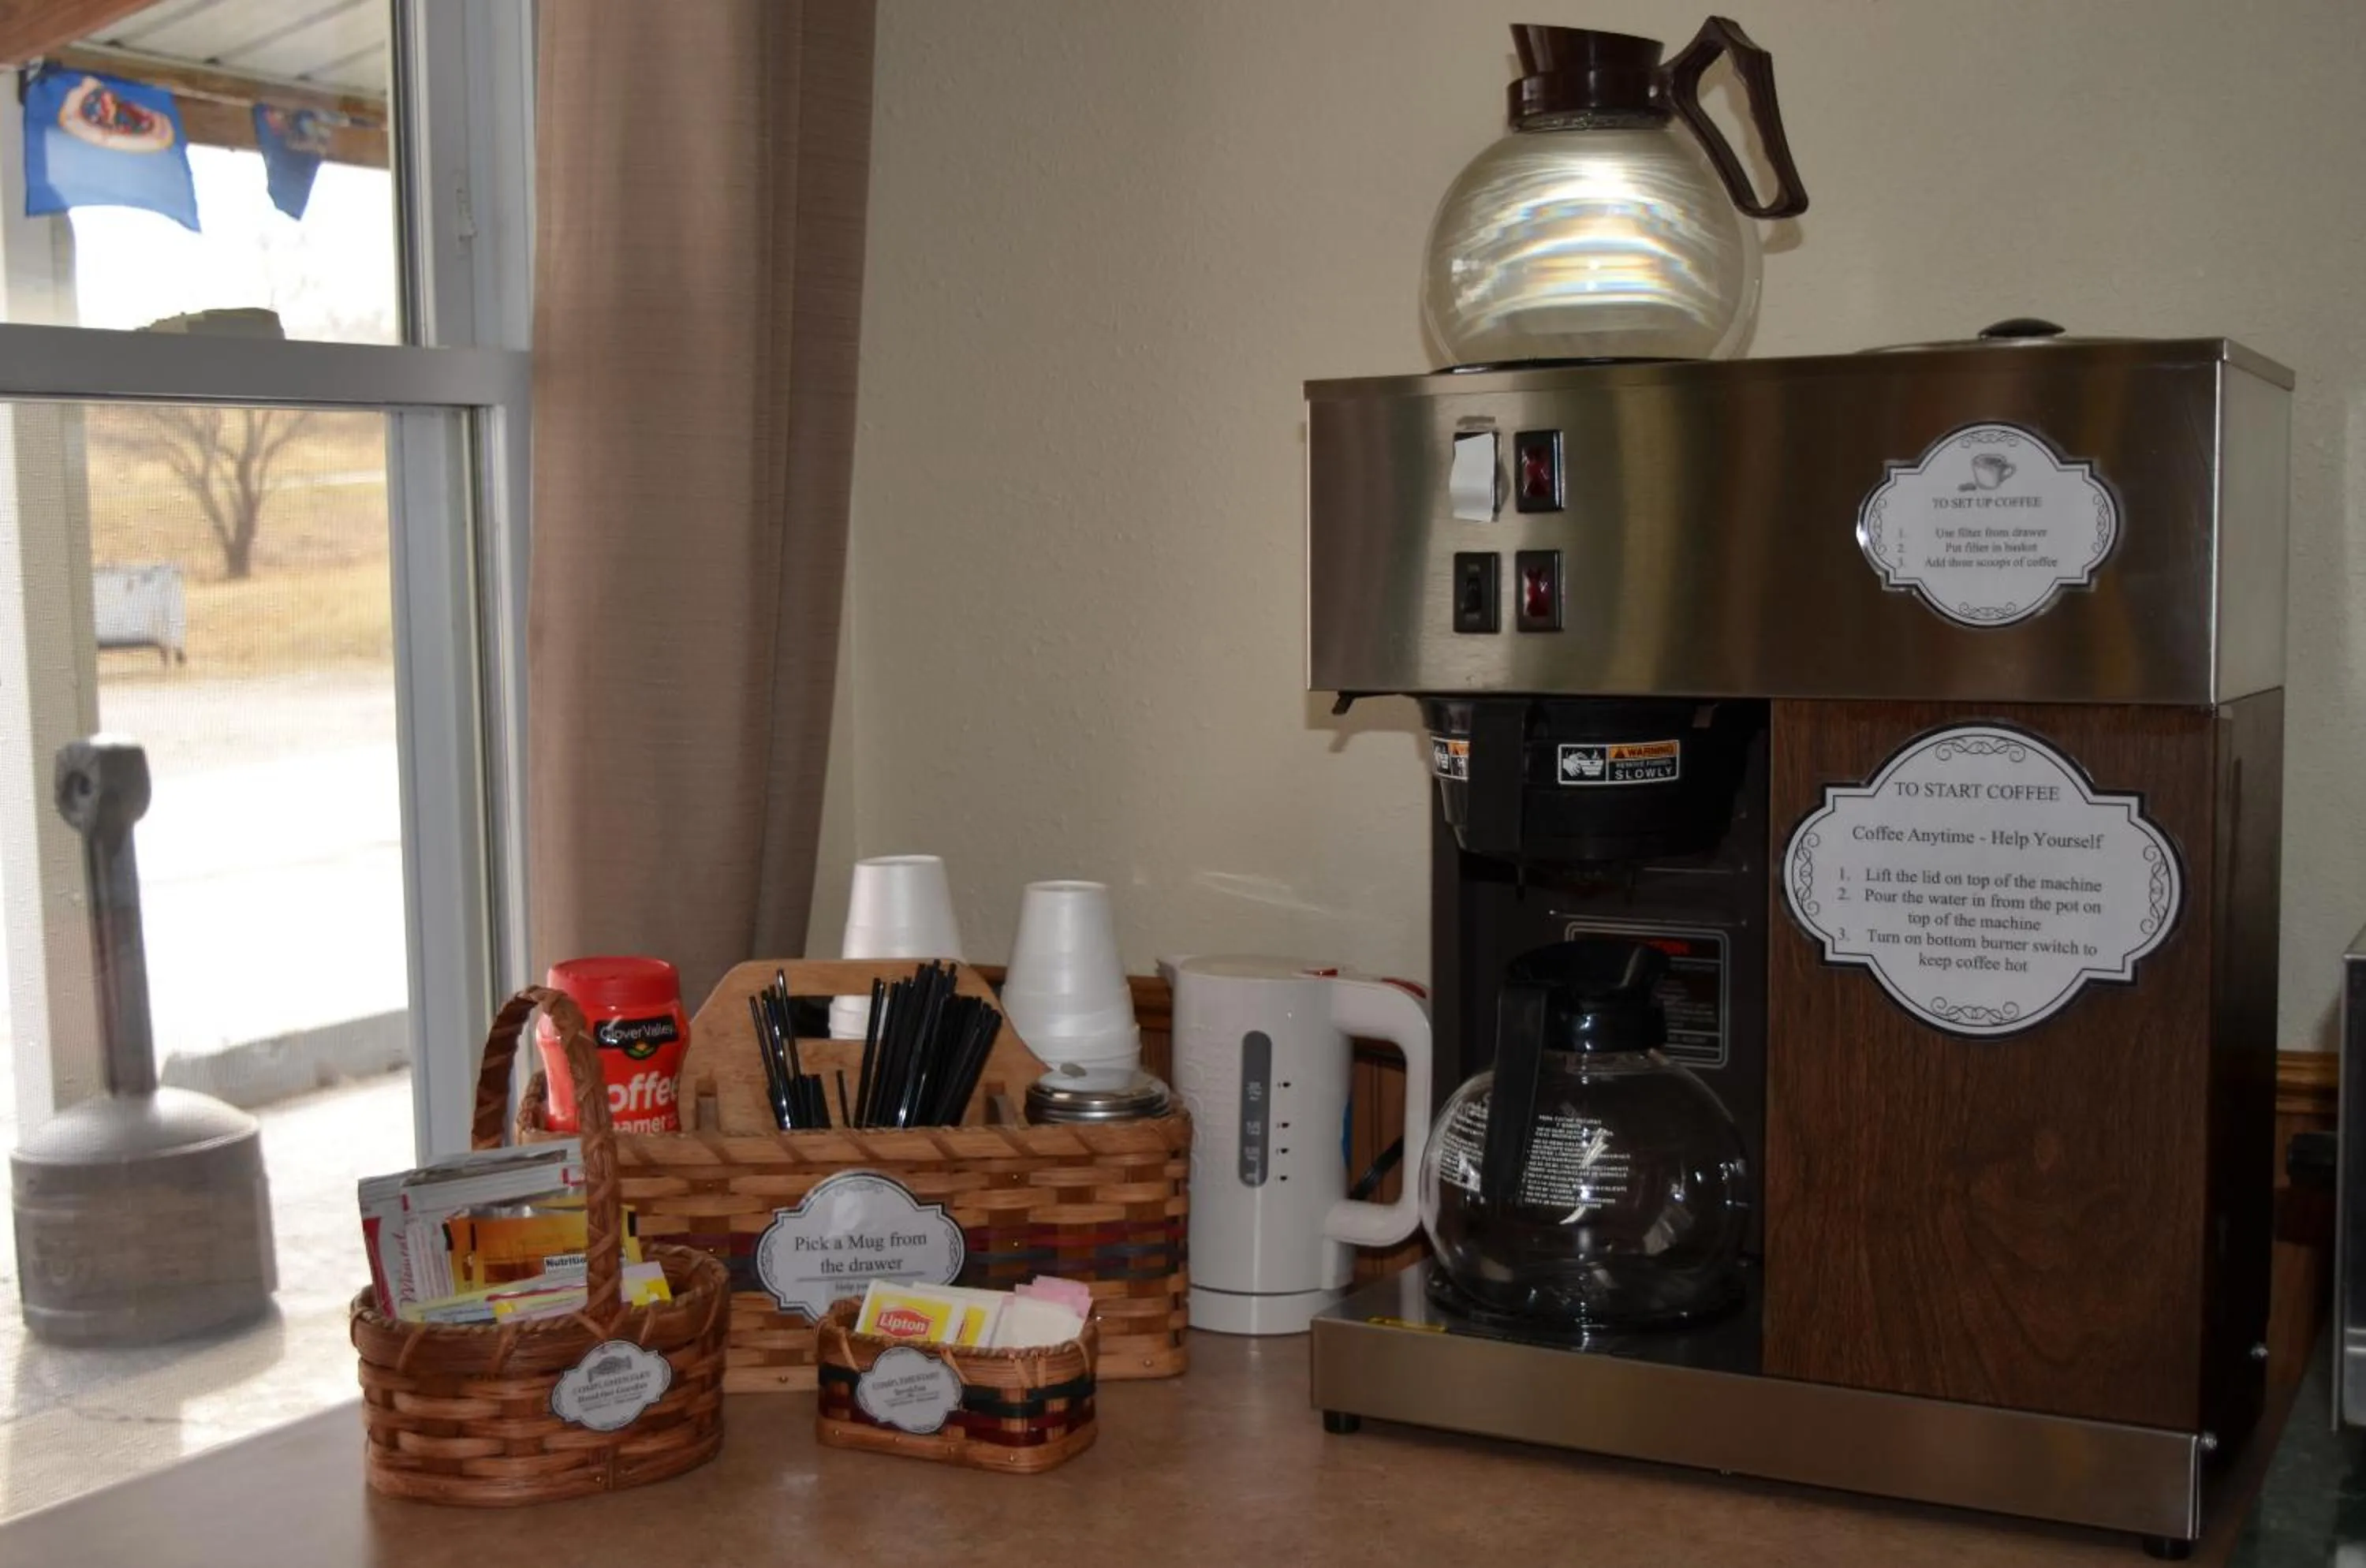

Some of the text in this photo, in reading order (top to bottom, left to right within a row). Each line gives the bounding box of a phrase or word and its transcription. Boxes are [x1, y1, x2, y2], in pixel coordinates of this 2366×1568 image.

[1932, 496, 2043, 509] TO SET UP COFFEE
[1935, 528, 1954, 539] Use
[1957, 527, 1981, 538] filter
[1985, 527, 2009, 538] from
[2012, 527, 2047, 538] drawer
[1946, 542, 1962, 553] Put
[1965, 541, 1989, 553] filter
[1992, 542, 2002, 552] in
[2005, 541, 2037, 552] basket
[1925, 556, 1946, 568] Add
[1949, 556, 1972, 567] three
[1976, 558, 2010, 569] scoops
[2013, 556, 2025, 567] of
[2027, 556, 2058, 568] coffee
[1615, 767, 1672, 780] SLOWLY
[1894, 782, 2060, 801] TO START COFFEE
[1853, 825, 1905, 842] Coffee
[1908, 828, 1974, 846] Anytime
[1991, 830, 2029, 850] Help
[2034, 832, 2104, 849] Yourself
[1839, 867, 2102, 892] 1. Lift the lid on top of the machine
[1837, 887, 2101, 914] 2. Pour the water in from the pot on
[1908, 912, 2041, 931] top of the machine
[1838, 927, 2098, 956] 3. Turn on bottom burner switch to
[1919, 952, 2028, 973] keep coffee hot
[599, 1025, 643, 1041] Clover
[607, 1070, 678, 1113] offee
[794, 1232, 927, 1252] Pick a Mug from
[821, 1256, 903, 1274] the drawer
[879, 1312, 927, 1333] Lipton
